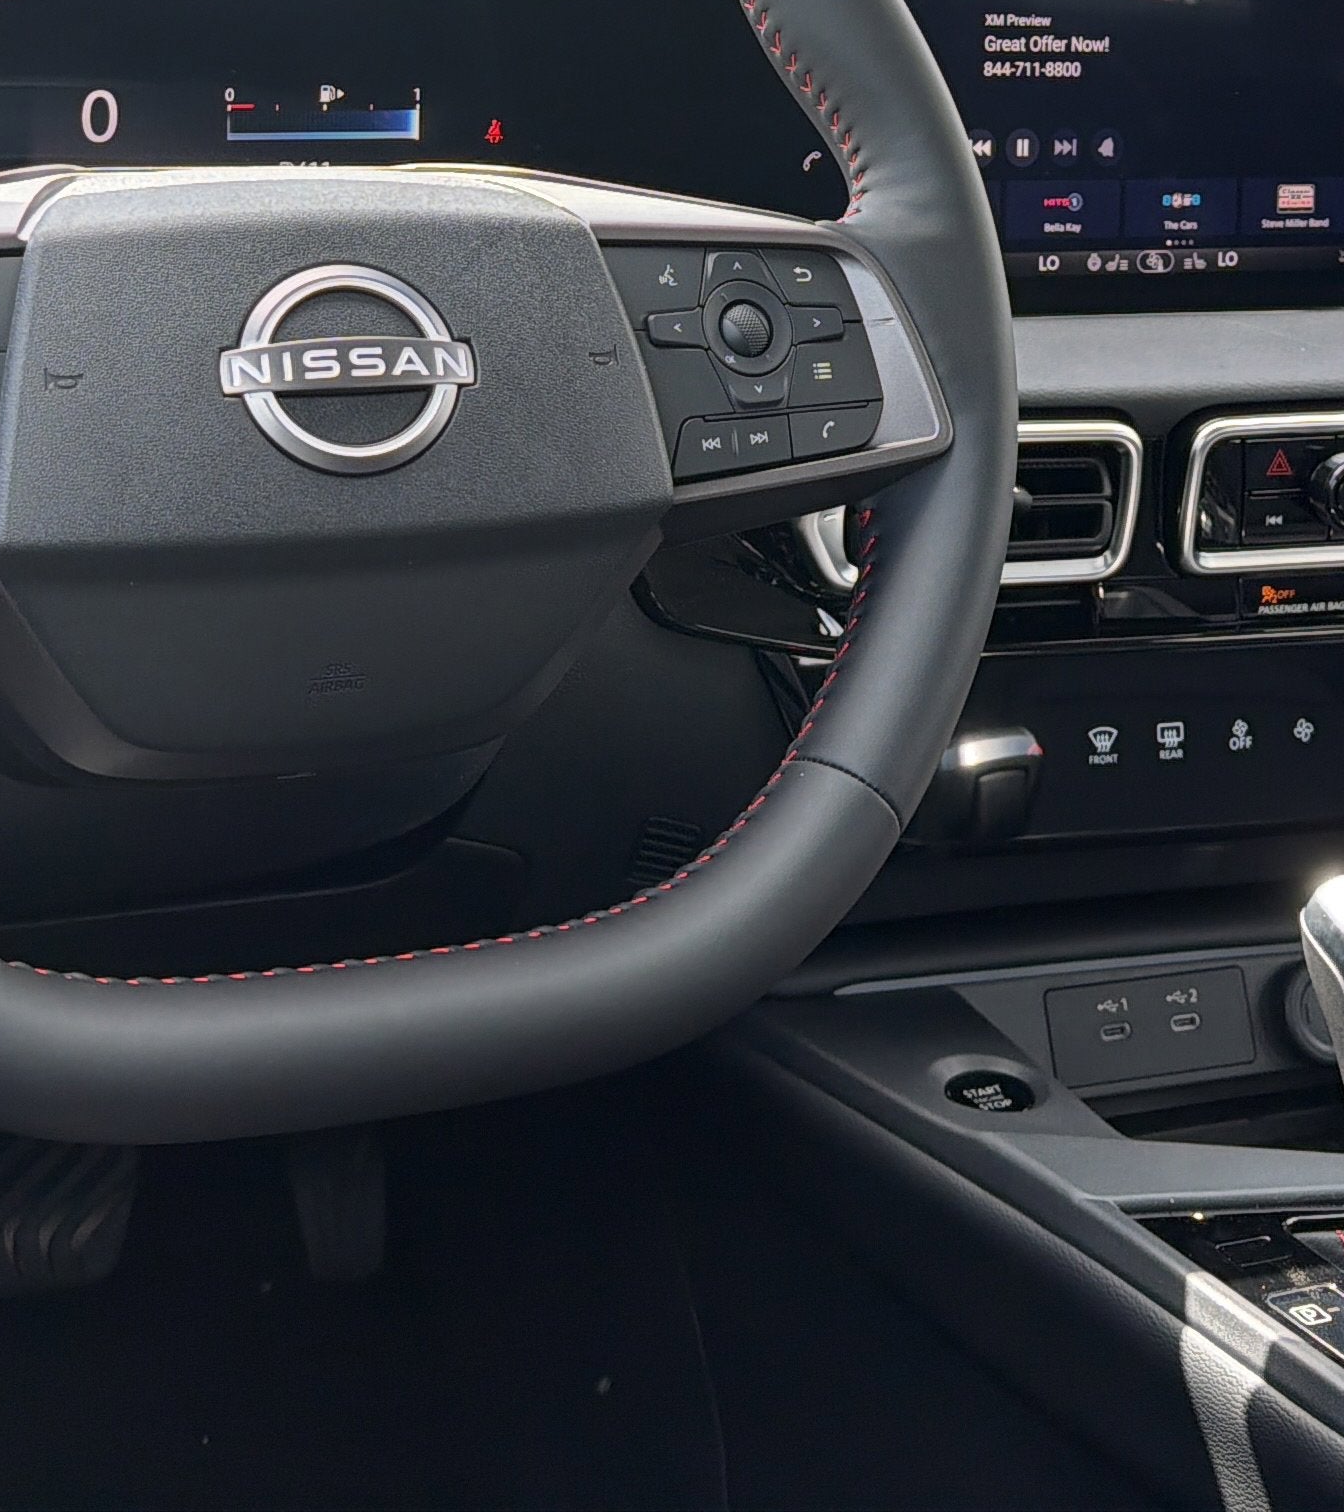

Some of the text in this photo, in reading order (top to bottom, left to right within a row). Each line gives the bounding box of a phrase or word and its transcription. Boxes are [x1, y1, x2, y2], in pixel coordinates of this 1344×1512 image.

[985, 14, 1052, 27] XM Preview
[985, 36, 1110, 53] Great Offer Now!
[983, 62, 1082, 77] 844-711-8800
[80, 89, 119, 144] 0
[1038, 255, 1061, 272] LO
[1217, 251, 1239, 268] LO
[230, 346, 469, 388] NISSAN
[1257, 602, 1309, 615] PASSENGER
[1228, 736, 1253, 751] OFF
[1088, 753, 1119, 766] FRONT
[1159, 748, 1184, 761] REAR
[962, 1084, 1001, 1099] START
